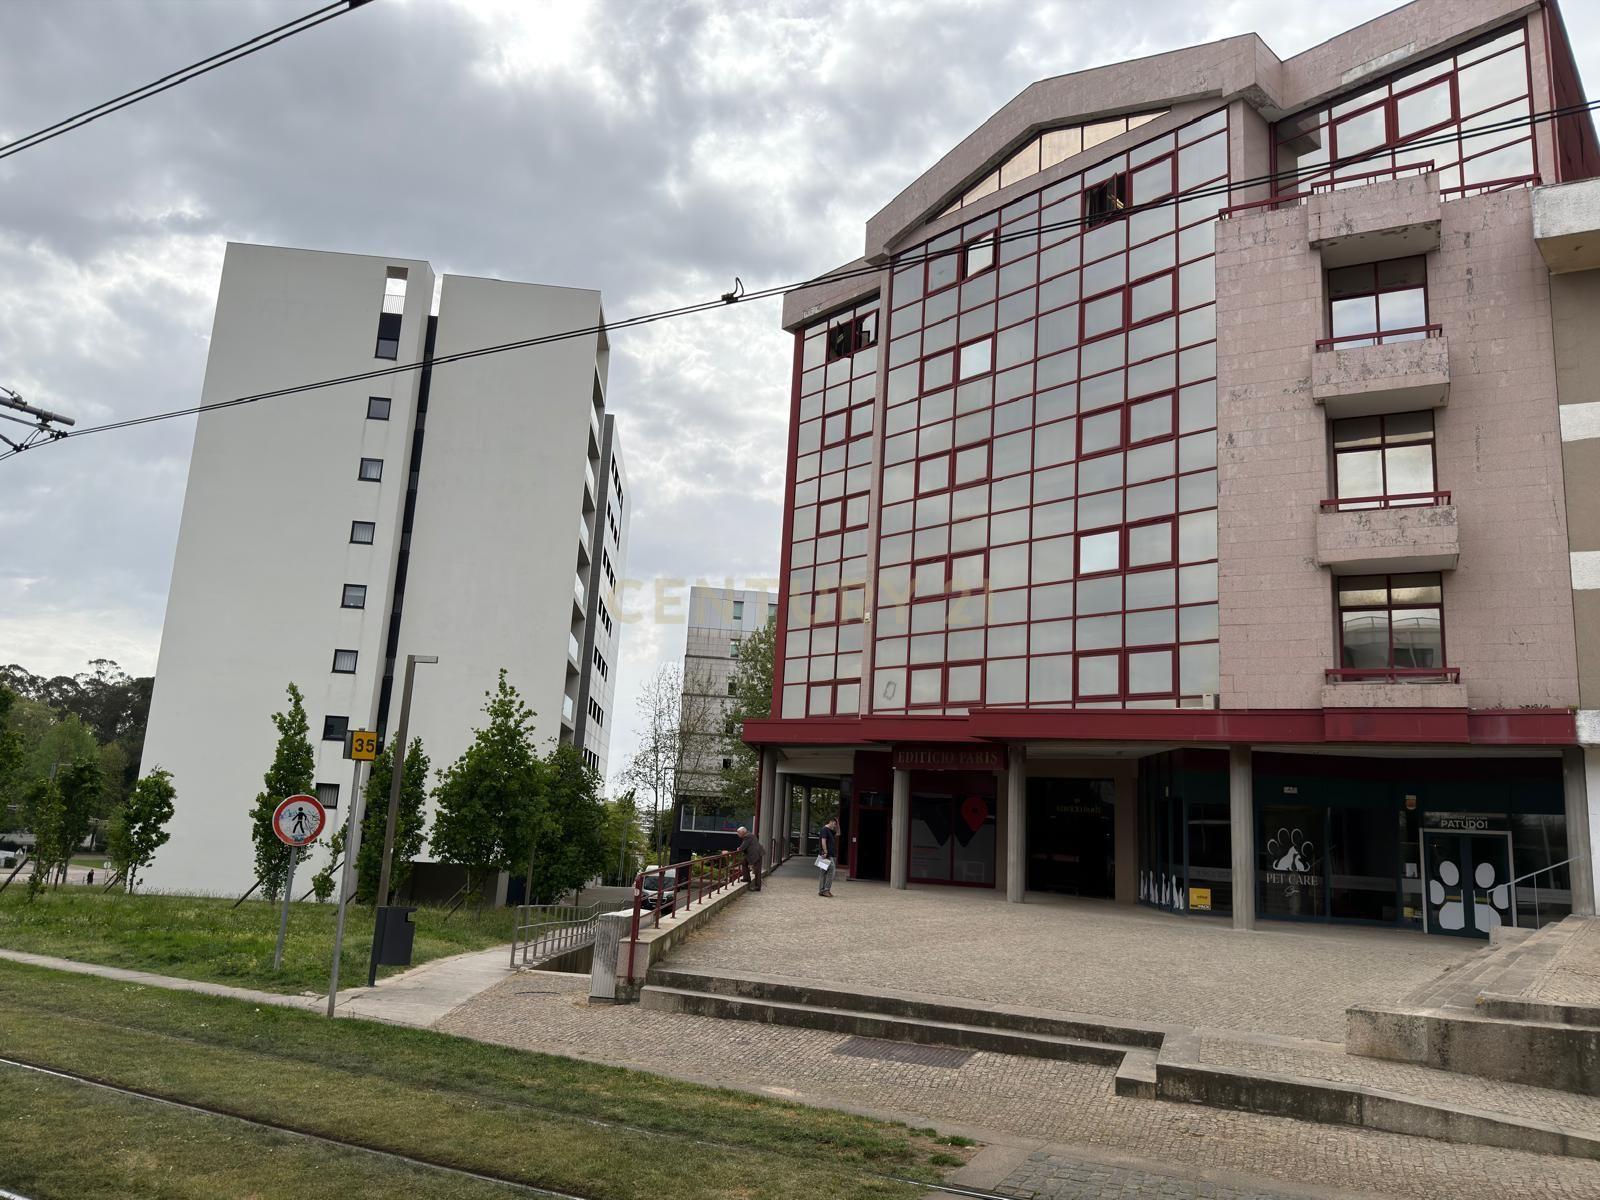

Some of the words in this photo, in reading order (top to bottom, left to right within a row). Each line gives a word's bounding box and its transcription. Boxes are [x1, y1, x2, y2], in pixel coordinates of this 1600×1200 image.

[354, 738, 375, 753] 35
[959, 752, 998, 765] PARIS
[1266, 872, 1286, 884] PET
[1288, 873, 1319, 886] CARE
